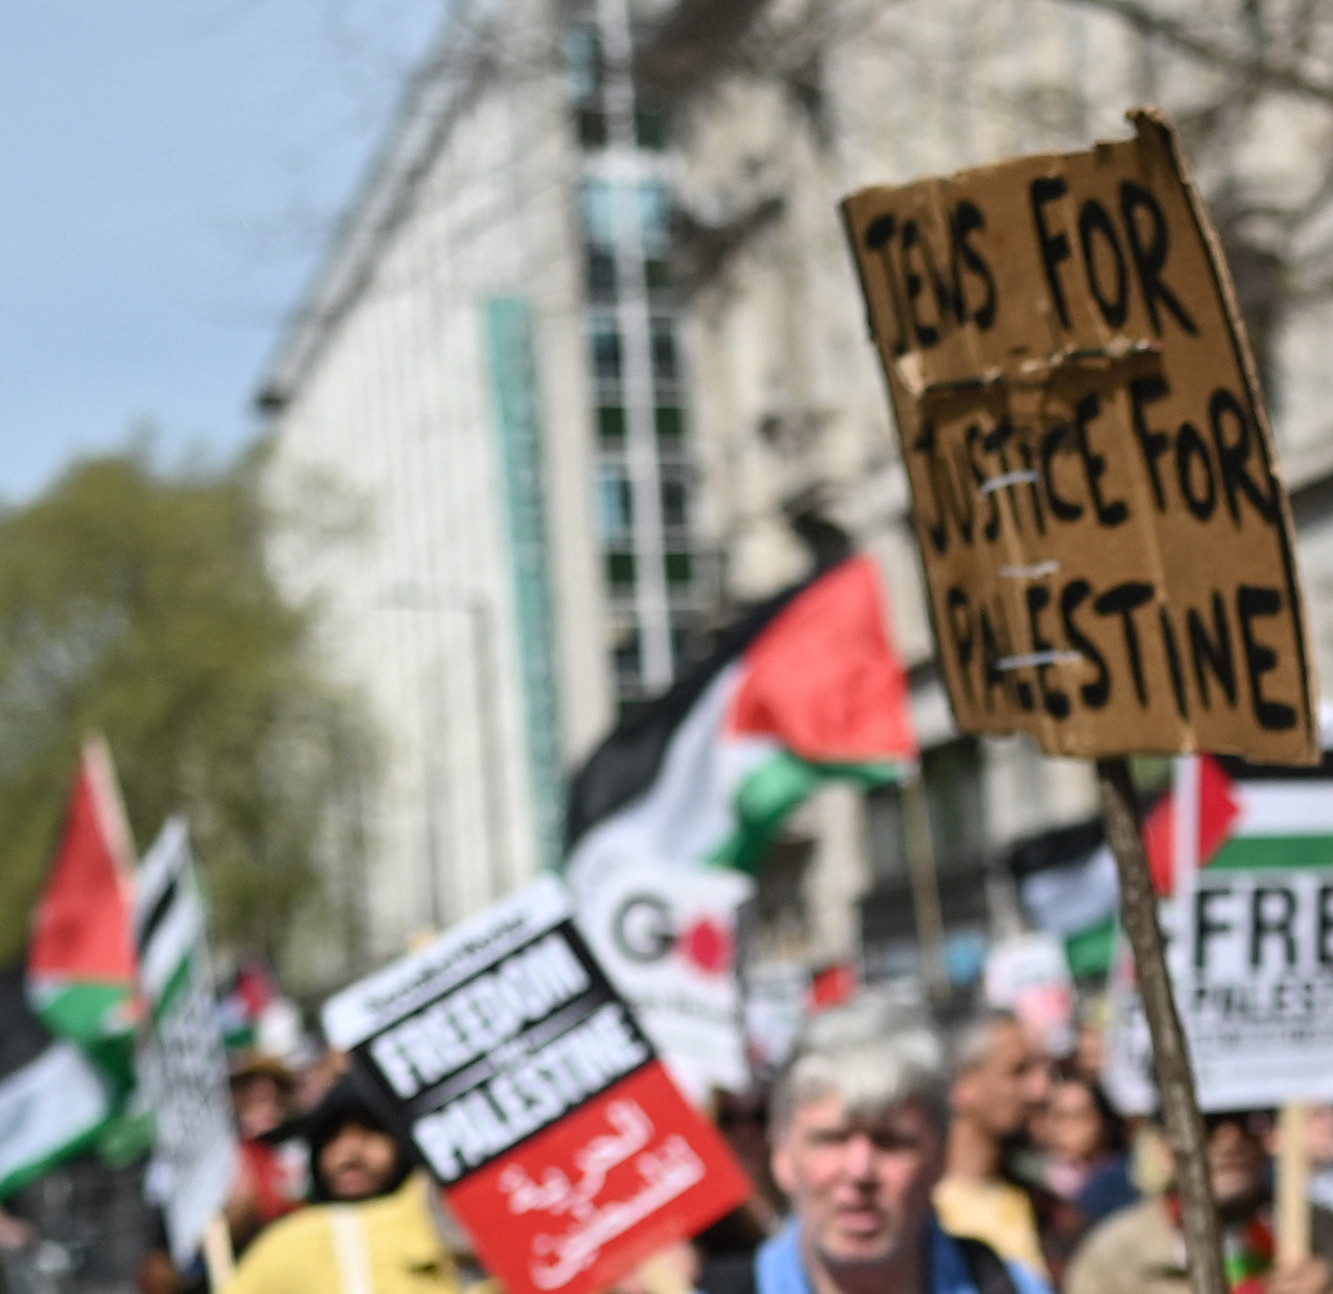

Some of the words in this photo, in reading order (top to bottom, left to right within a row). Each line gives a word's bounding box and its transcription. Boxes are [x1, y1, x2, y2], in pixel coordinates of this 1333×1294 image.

[864, 200, 998, 353] JEWS
[1029, 176, 1200, 338] FOR
[914, 389, 1128, 554] JUSTICE
[1130, 375, 1280, 530] FOR
[946, 577, 1299, 731] PALESTINE
[369, 930, 594, 1100] FREEDOM
[410, 1000, 653, 1184] PALESTINE
